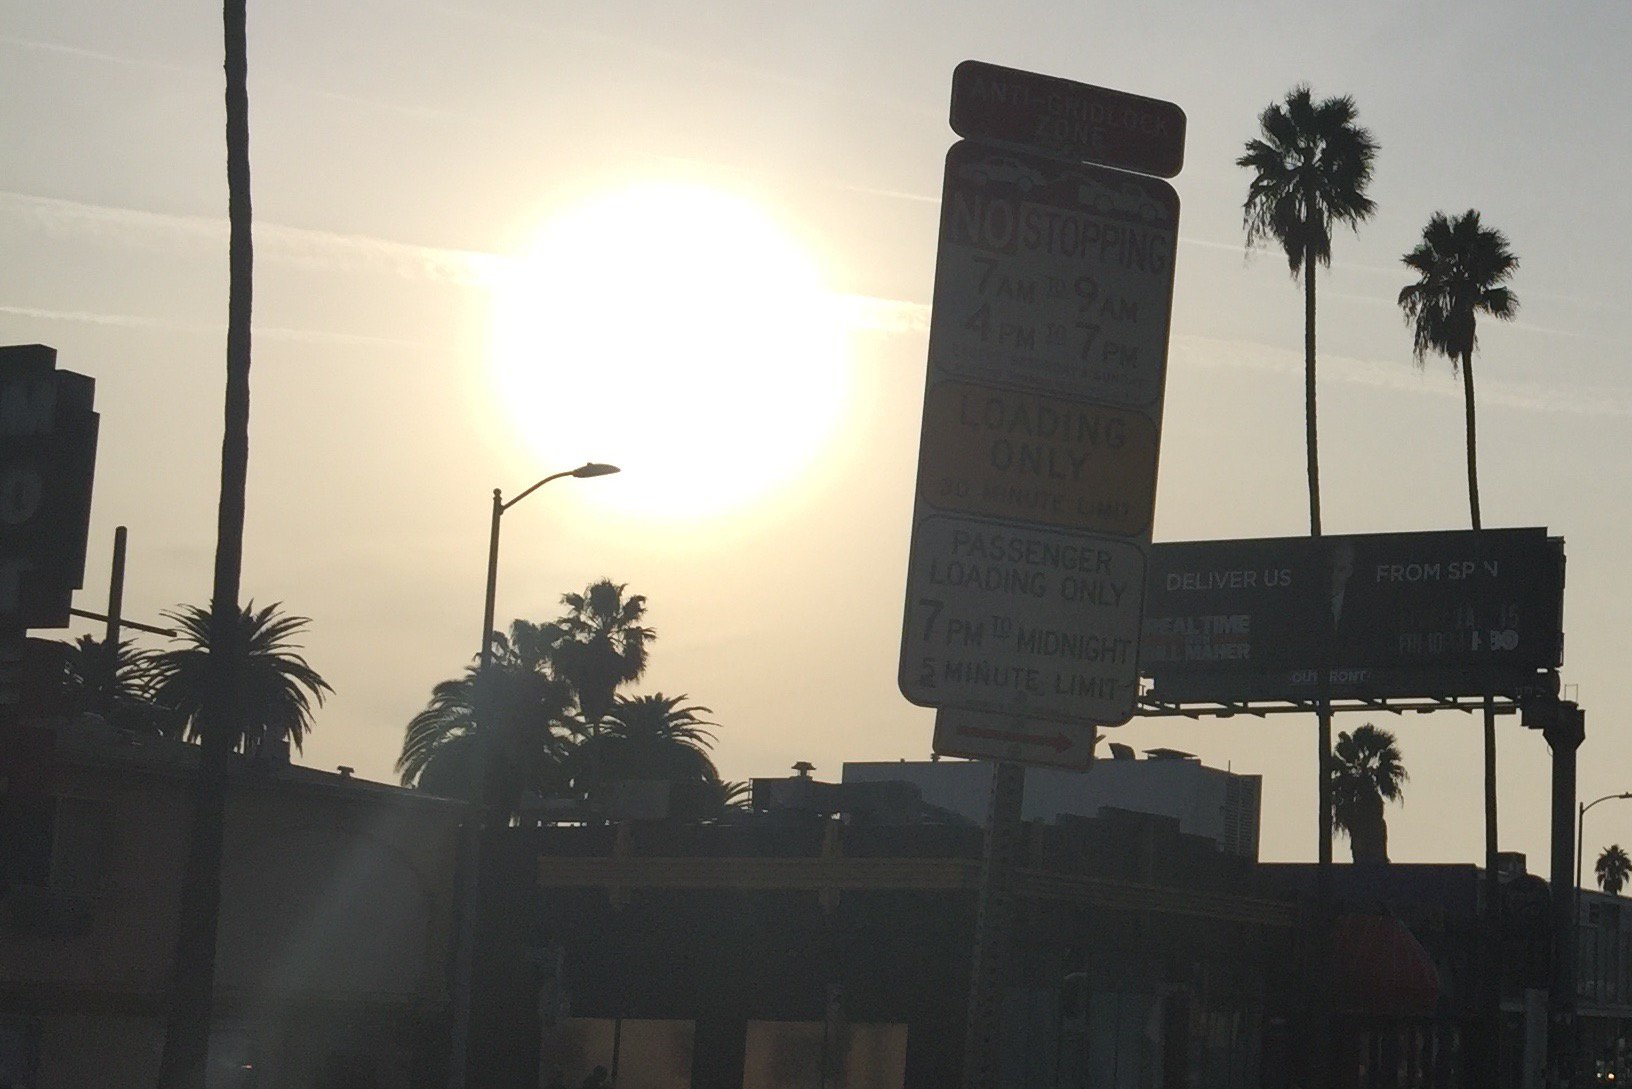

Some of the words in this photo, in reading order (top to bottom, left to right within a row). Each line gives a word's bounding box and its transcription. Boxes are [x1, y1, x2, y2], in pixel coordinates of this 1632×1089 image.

[1035, 114, 1106, 148] ZONE
[951, 191, 1013, 248] NO
[1022, 207, 1167, 276] STOPPING
[972, 255, 998, 294] 7
[996, 276, 1036, 304] AM
[1073, 276, 1098, 312] 9
[1100, 297, 1138, 323] AM
[963, 302, 991, 342] 4
[998, 323, 1036, 350] PM
[1075, 321, 1101, 360] 7
[1102, 340, 1140, 369] PM
[960, 394, 1126, 449] LOADING
[991, 438, 1092, 481] ONLY
[951, 530, 1112, 576] PASSENGER
[1376, 563, 1440, 582] FROM
[1448, 560, 1498, 580] SPN
[930, 558, 1046, 599] LOADING
[1061, 577, 1128, 607] ONLY
[1166, 569, 1257, 591] DELIVER
[1263, 568, 1292, 587] US
[919, 598, 944, 642] 7
[946, 618, 982, 647] PM
[992, 615, 1012, 639] TO
[1017, 625, 1132, 664] MIDNIGHT
[918, 657, 937, 689] 5
[939, 659, 1041, 692] MINUTE
[1055, 673, 1119, 700] LIMIT
